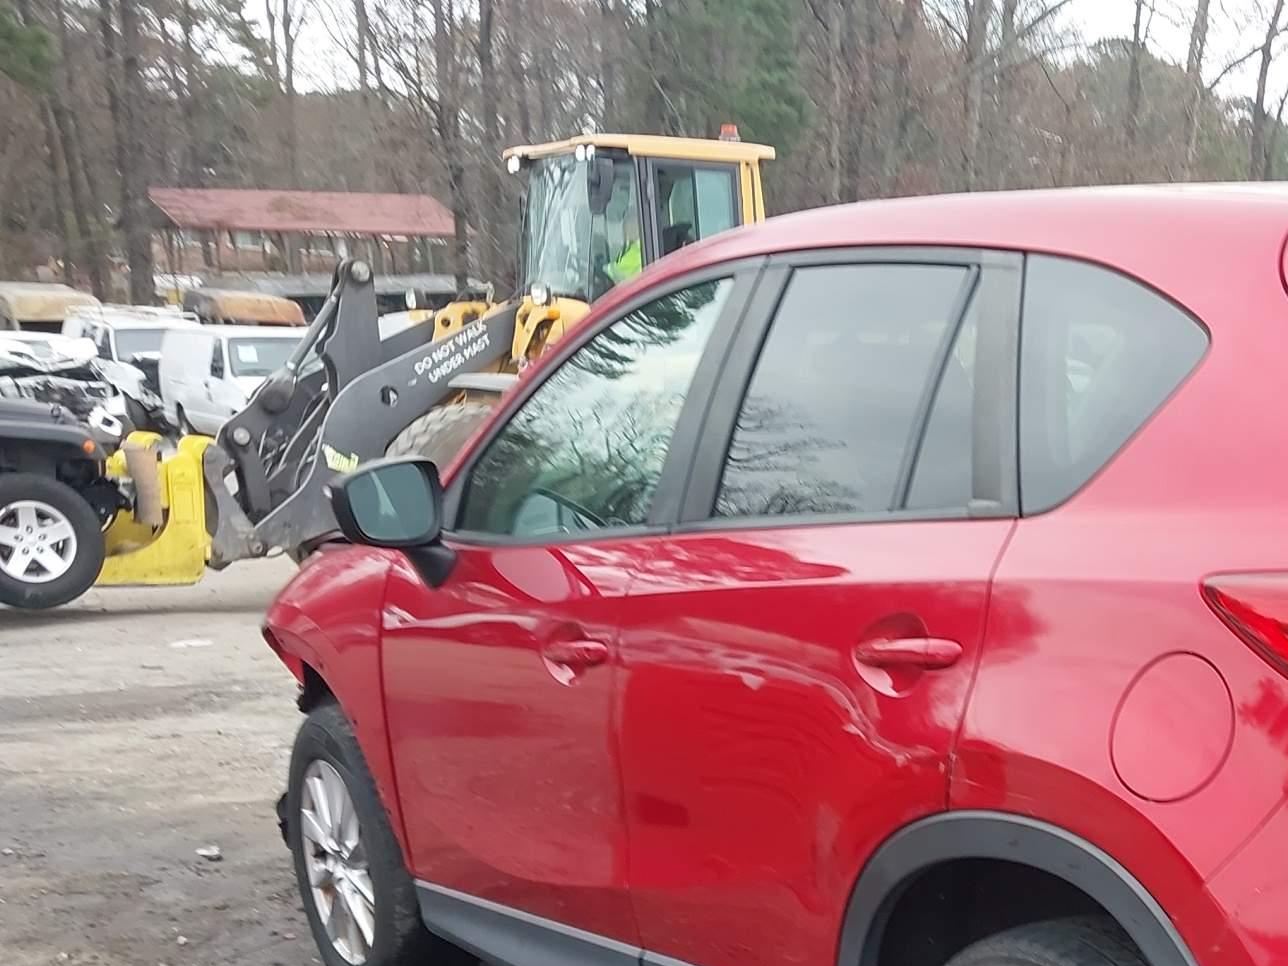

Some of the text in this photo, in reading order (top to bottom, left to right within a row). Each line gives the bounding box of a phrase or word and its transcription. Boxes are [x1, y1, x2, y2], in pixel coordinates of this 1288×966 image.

[414, 320, 487, 375] DO NOT WALK
[428, 332, 490, 383] UNDER MAST
